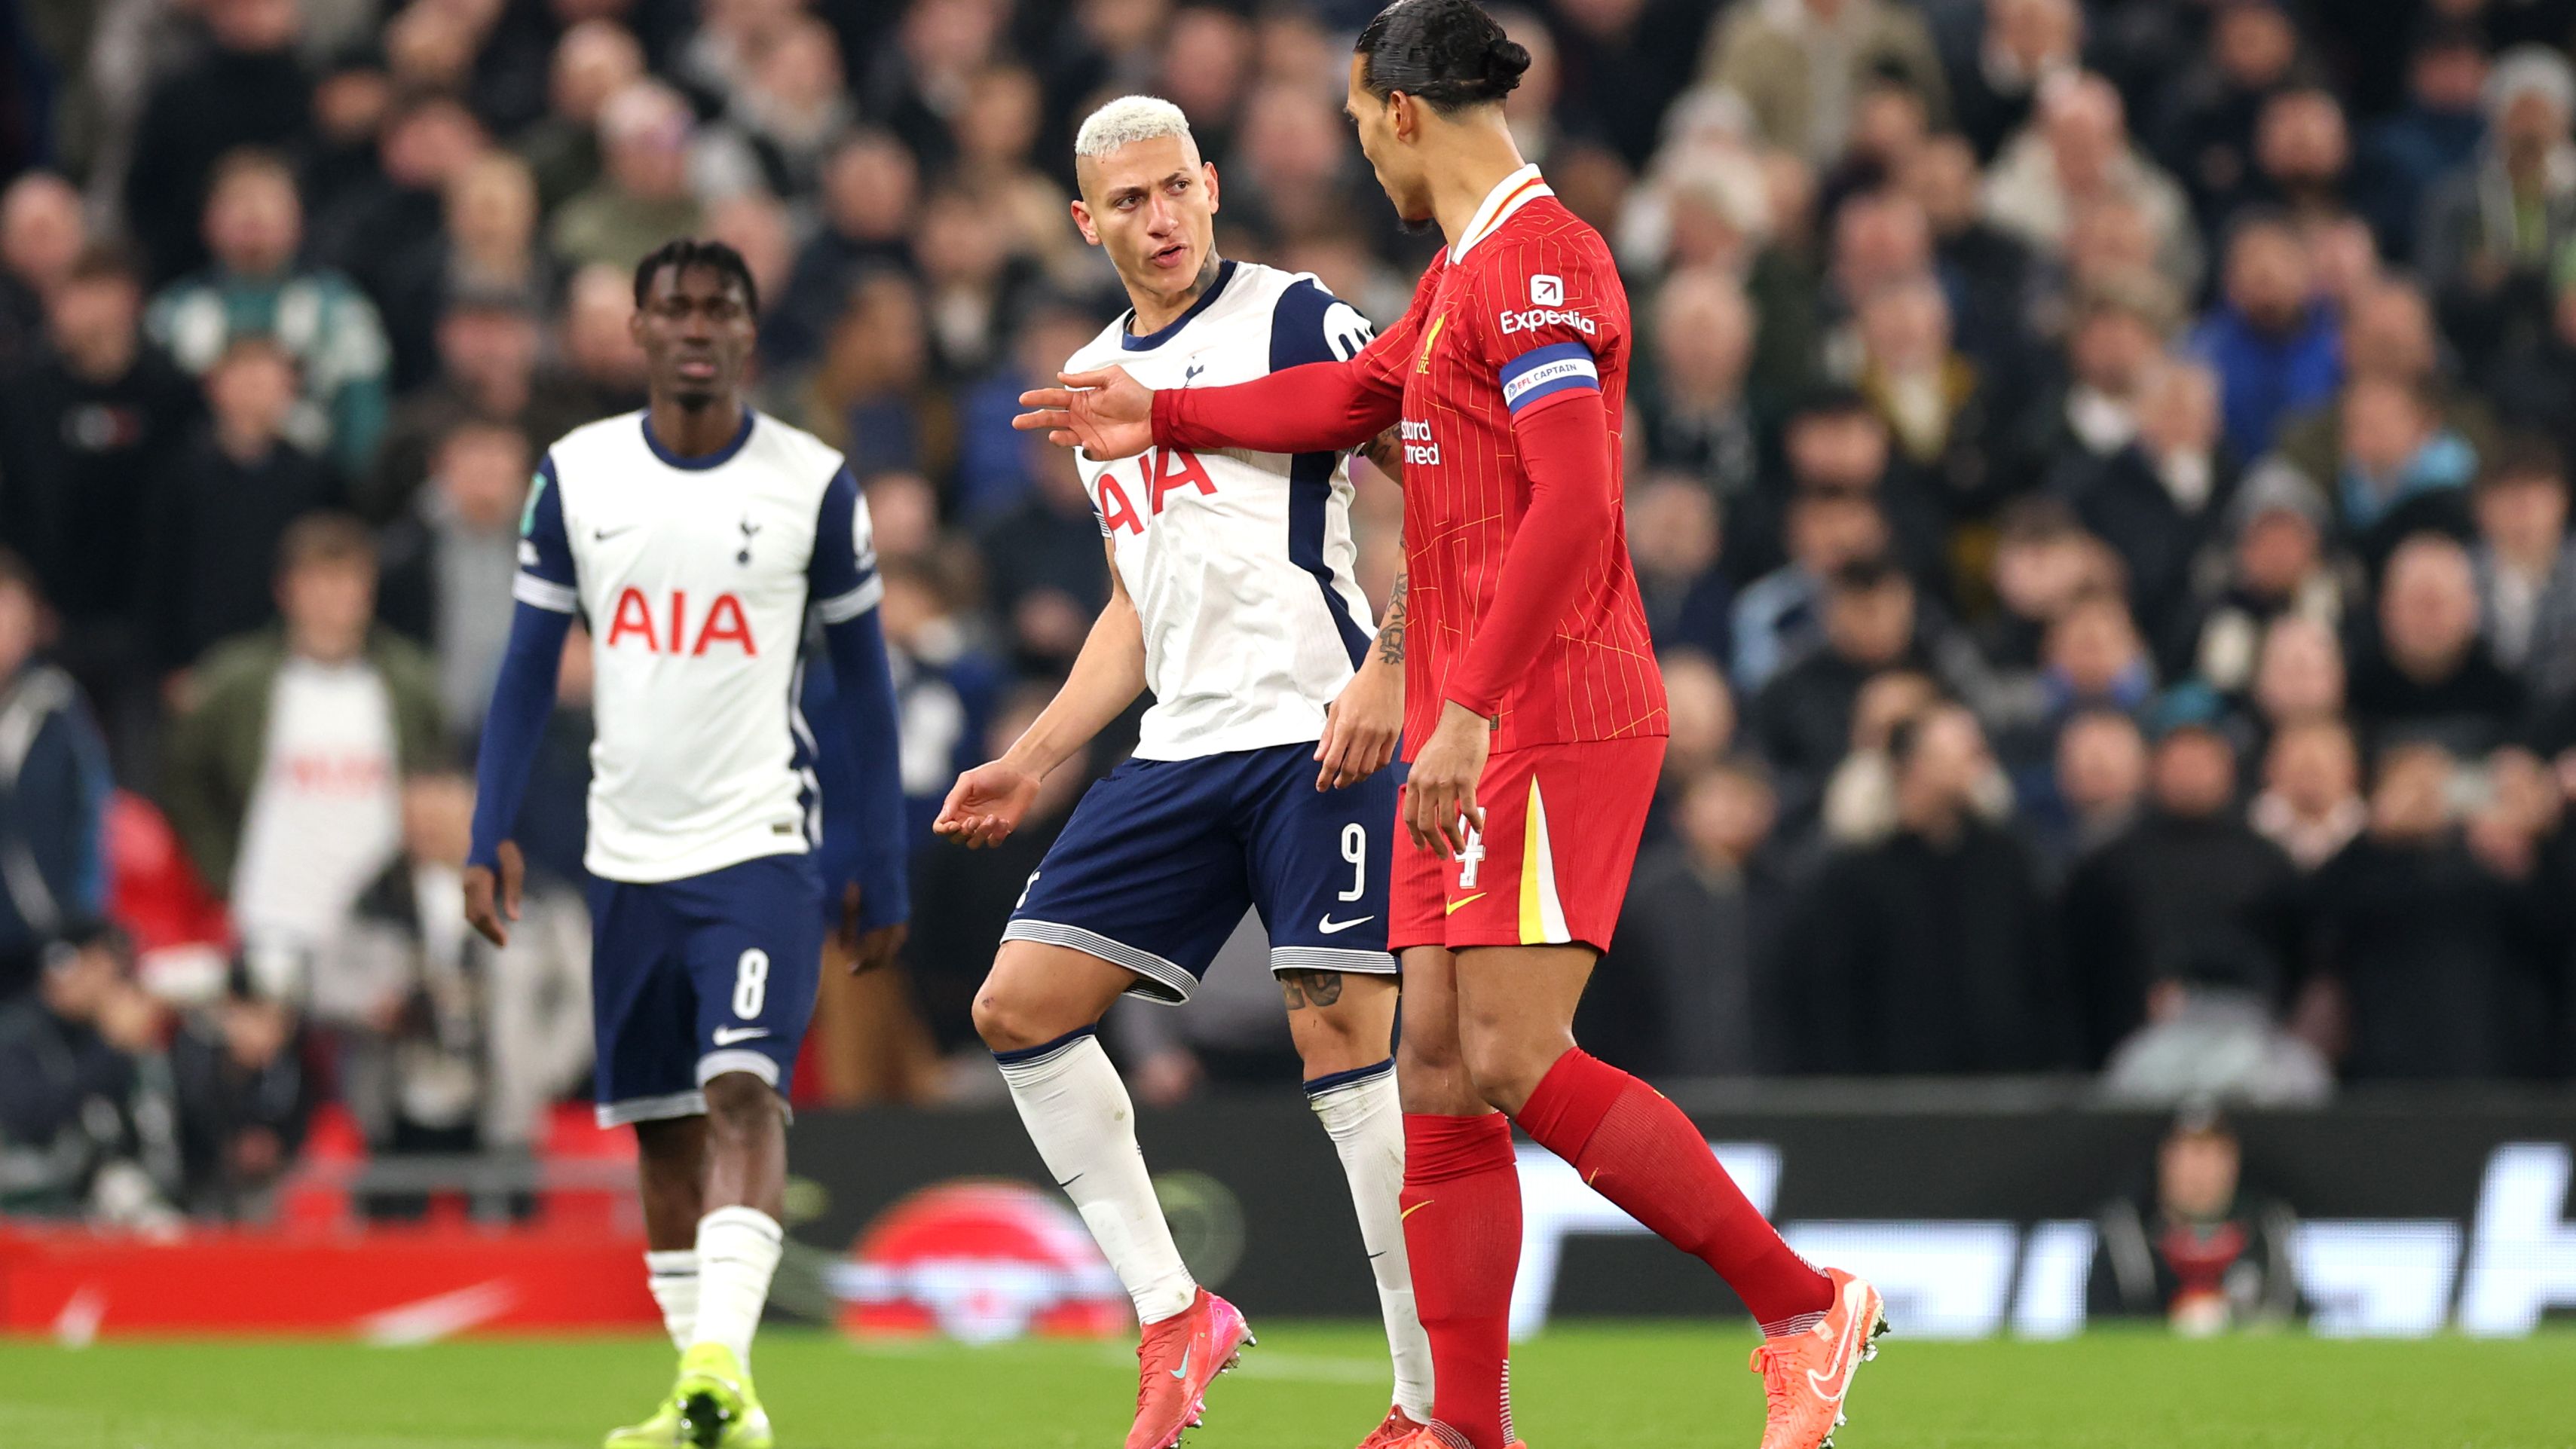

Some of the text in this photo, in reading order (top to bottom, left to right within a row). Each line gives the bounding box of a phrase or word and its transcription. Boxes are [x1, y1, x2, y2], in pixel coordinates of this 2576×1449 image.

[1500, 309, 1595, 335] Expedia
[1516, 364, 1577, 390] EFL CAPTAIN
[607, 586, 758, 658] AIA
[1338, 822, 1366, 901] 9
[1453, 806, 1487, 889] 4
[732, 947, 769, 1020] 8
